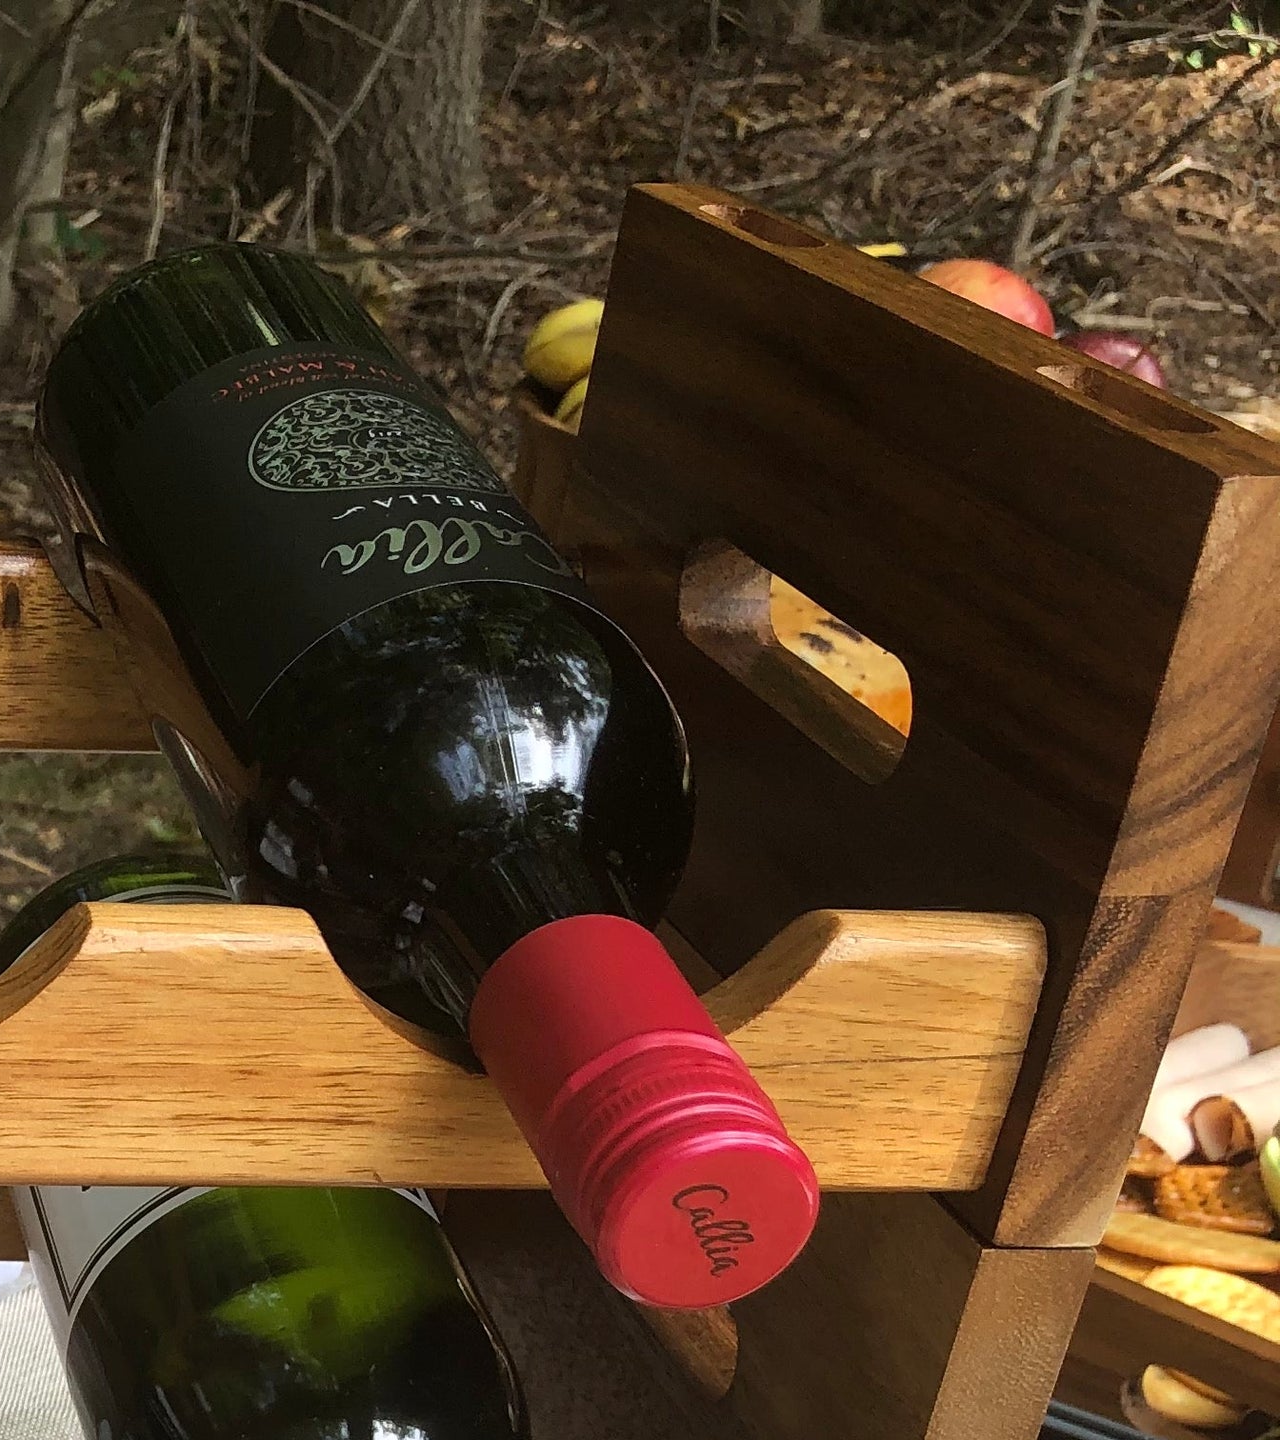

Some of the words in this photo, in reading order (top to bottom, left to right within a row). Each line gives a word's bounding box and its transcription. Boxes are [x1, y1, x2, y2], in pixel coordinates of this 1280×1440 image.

[372, 494, 486, 512] BELLA
[321, 517, 572, 579] Callia
[672, 1183, 755, 1278] Callia
